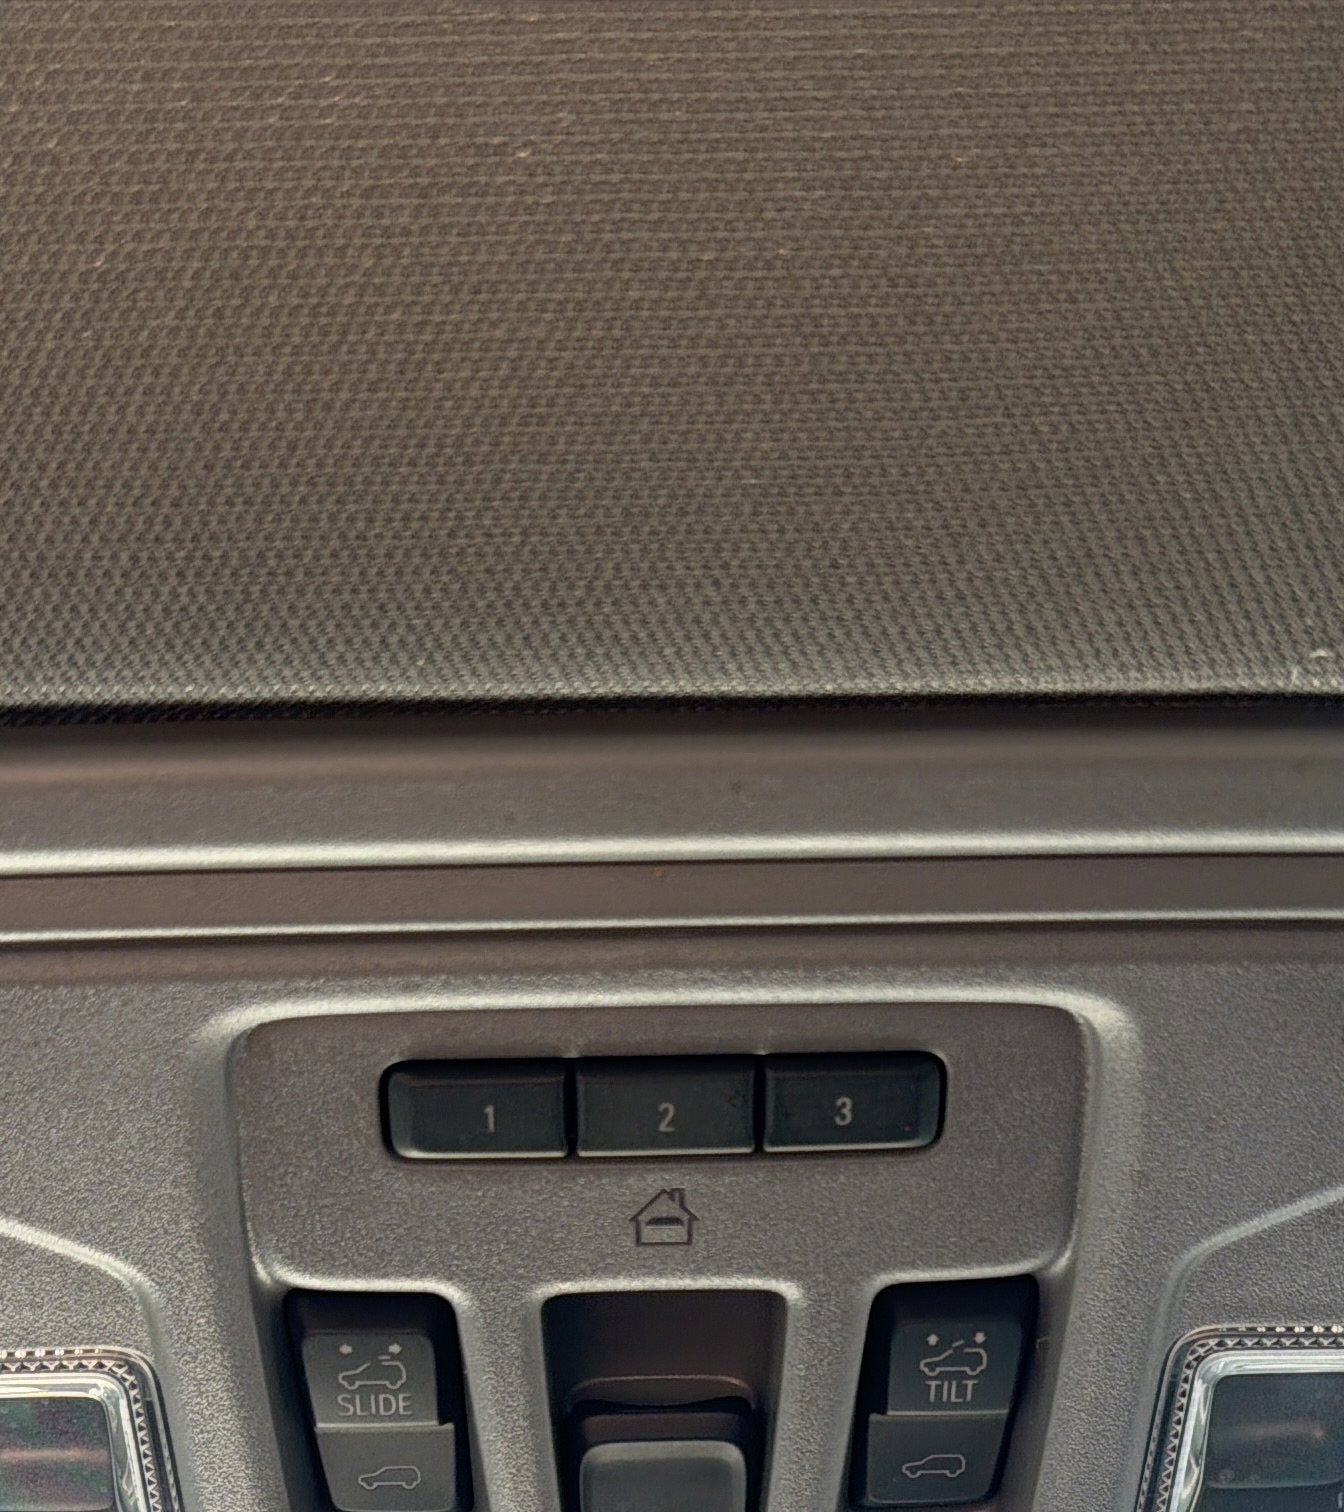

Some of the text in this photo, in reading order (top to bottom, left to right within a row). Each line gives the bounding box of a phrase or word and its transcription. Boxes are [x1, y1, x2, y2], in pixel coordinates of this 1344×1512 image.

[484, 1105, 496, 1133] 1
[659, 1103, 676, 1133] 2
[834, 1097, 853, 1126] 3
[337, 1393, 413, 1417] SLIDE
[925, 1380, 979, 1403] TILT
